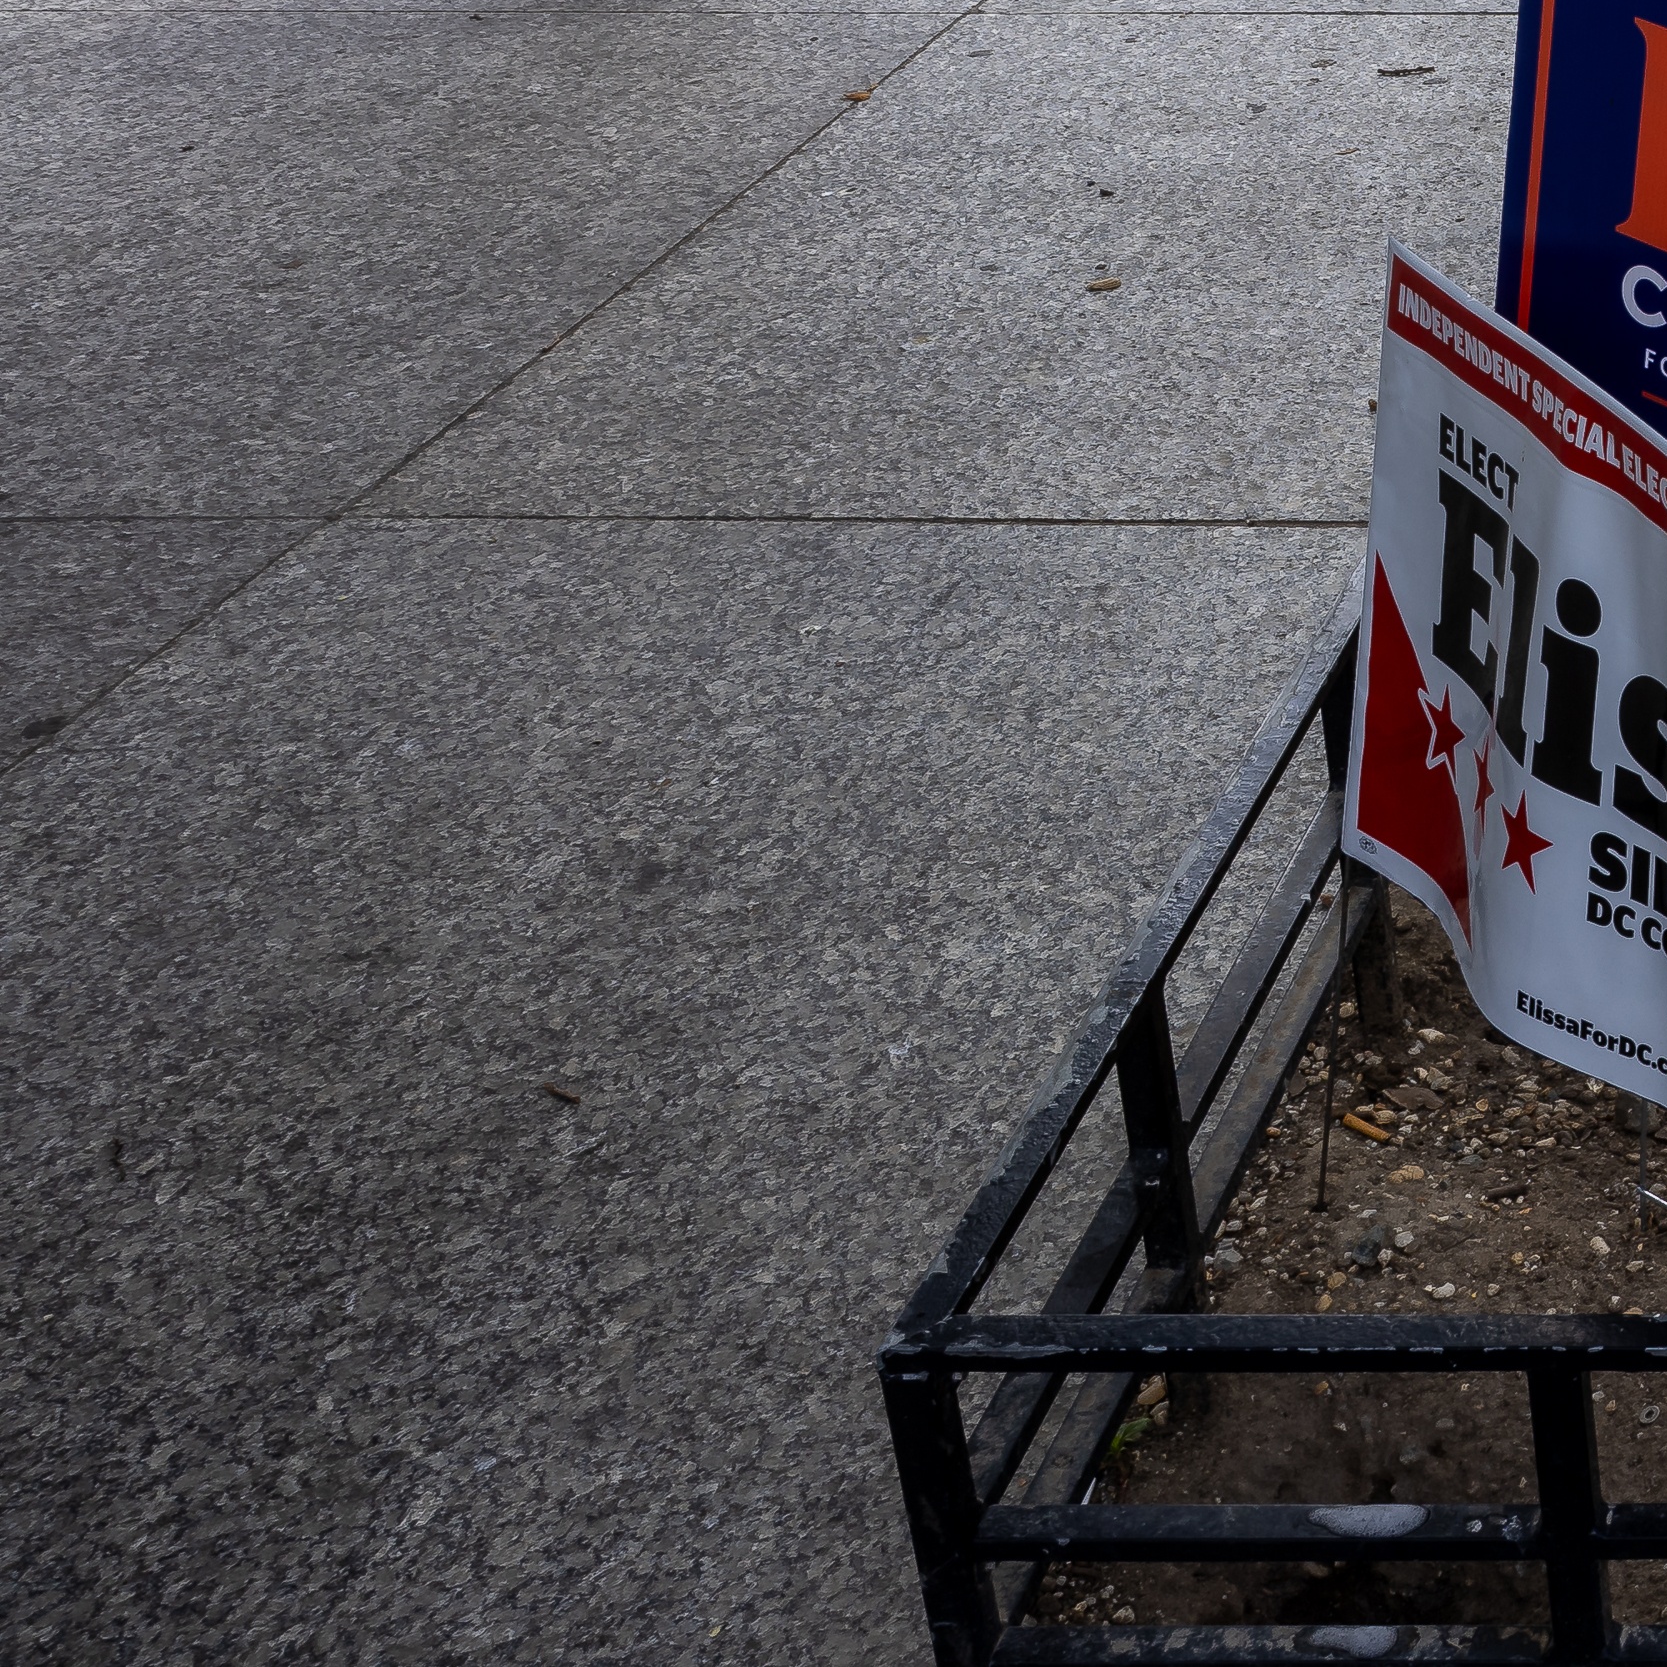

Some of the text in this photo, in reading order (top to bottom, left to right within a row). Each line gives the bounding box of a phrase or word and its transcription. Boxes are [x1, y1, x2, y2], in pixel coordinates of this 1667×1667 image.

[1396, 280, 1531, 401] INDEPENDENT
[1530, 379, 1621, 470] SPECIAL
[1437, 411, 1520, 513] ELECT
[1585, 890, 1636, 941] DC
